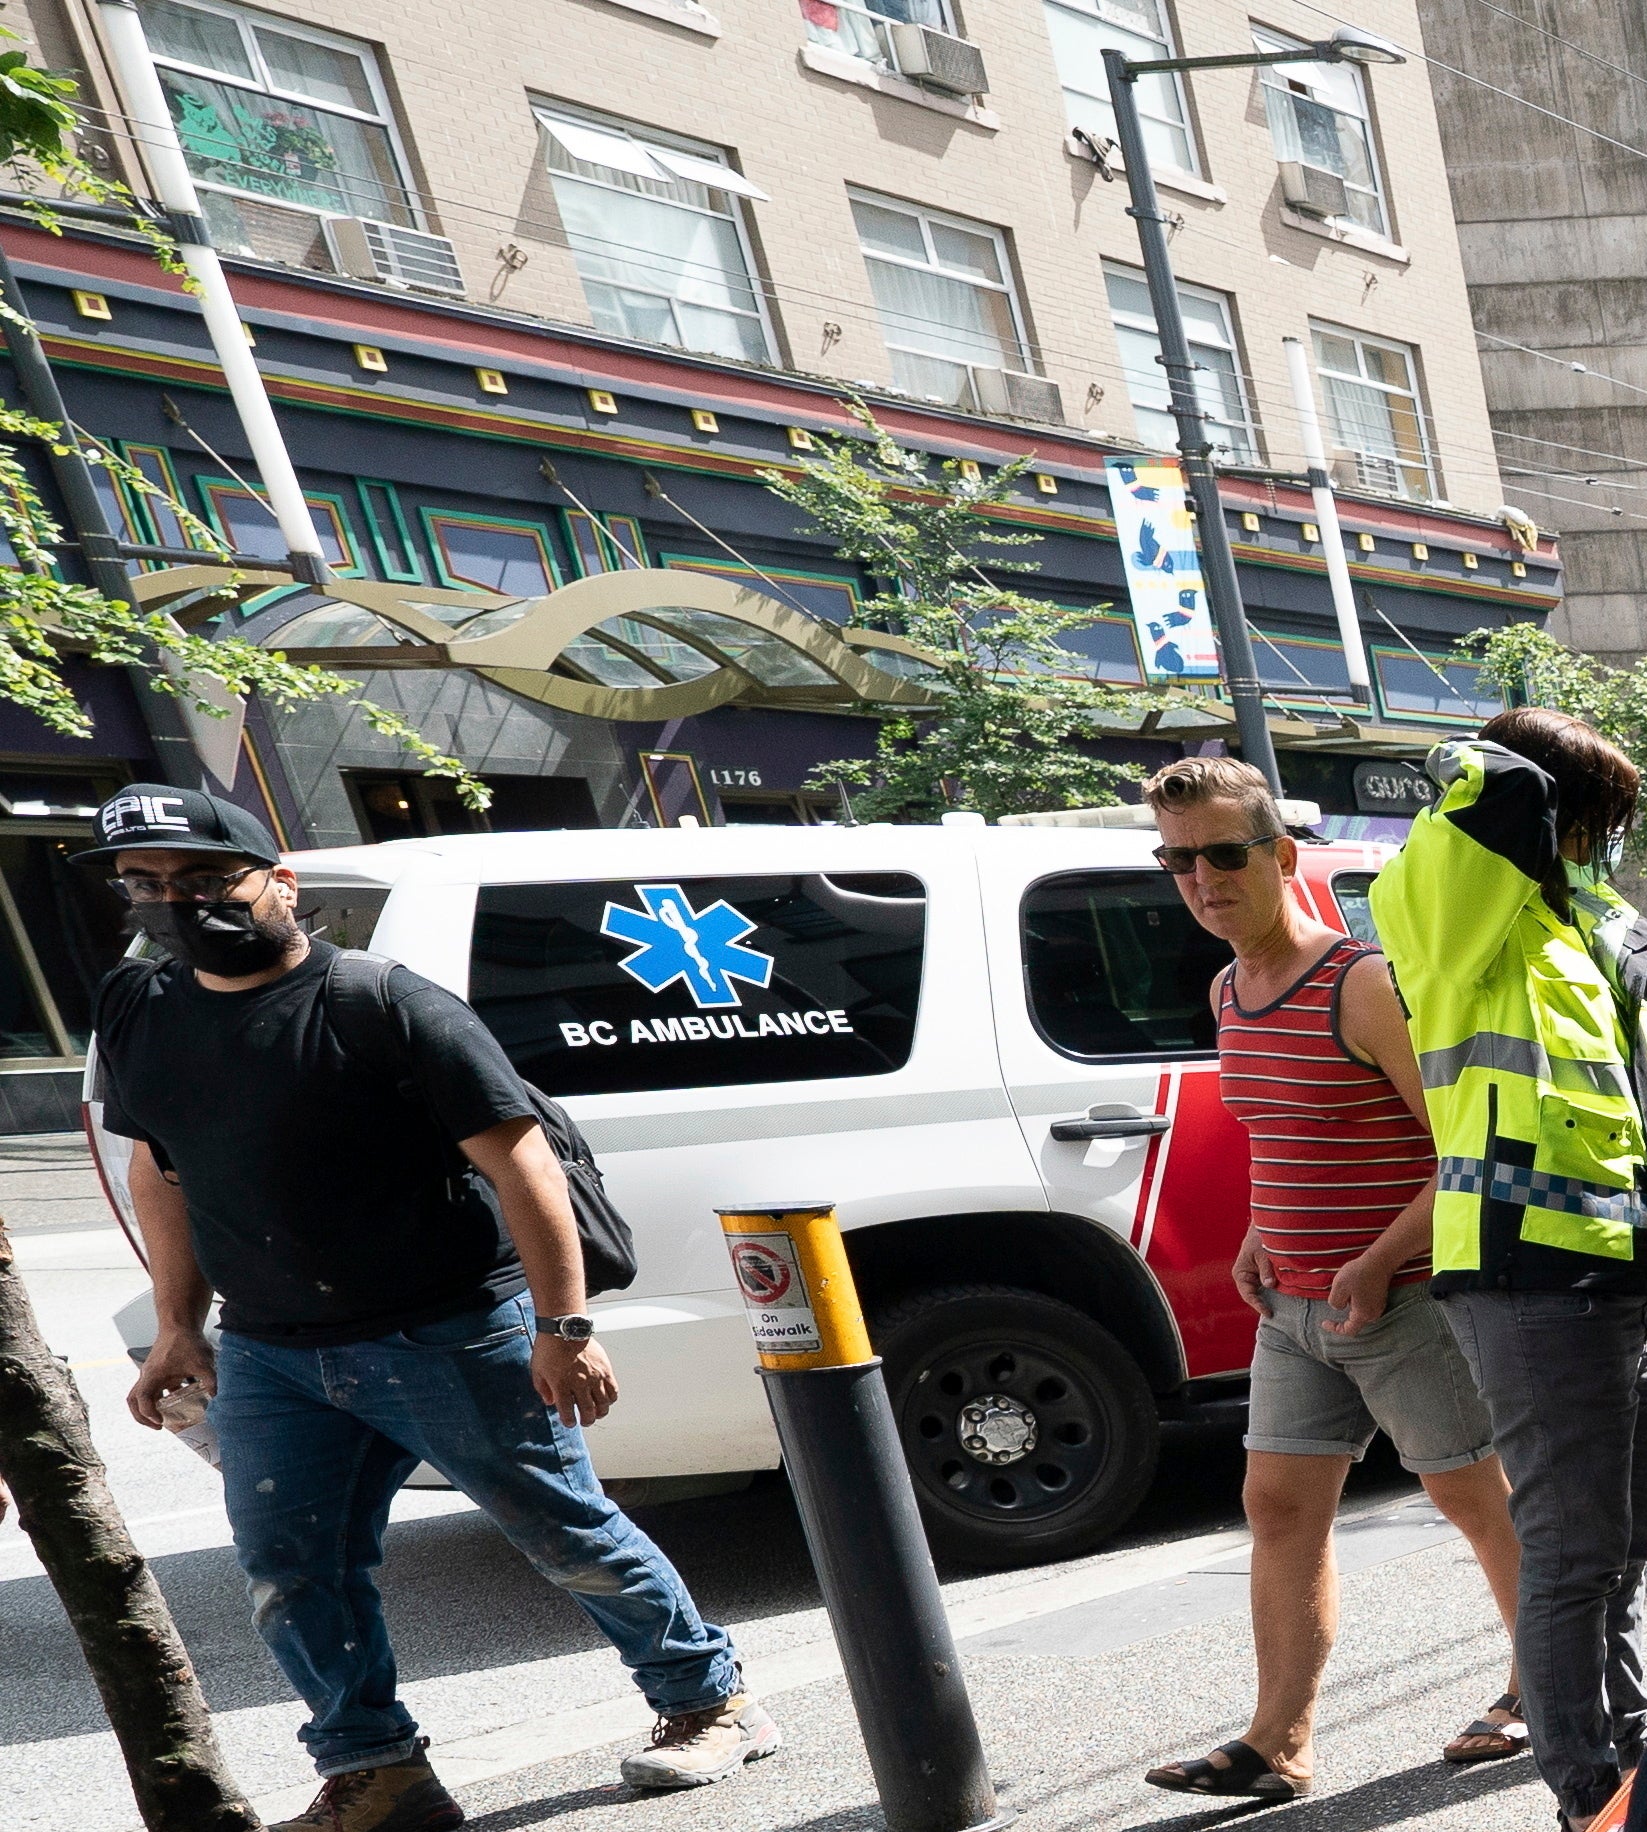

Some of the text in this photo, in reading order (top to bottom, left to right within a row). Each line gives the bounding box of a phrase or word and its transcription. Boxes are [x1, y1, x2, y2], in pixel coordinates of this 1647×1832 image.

[710, 769, 762, 786] 1176
[102, 796, 189, 834] EPIC
[559, 1010, 853, 1047] BC AMBULANCE
[761, 1313, 779, 1323] On
[752, 1323, 812, 1337] Sidewalk
